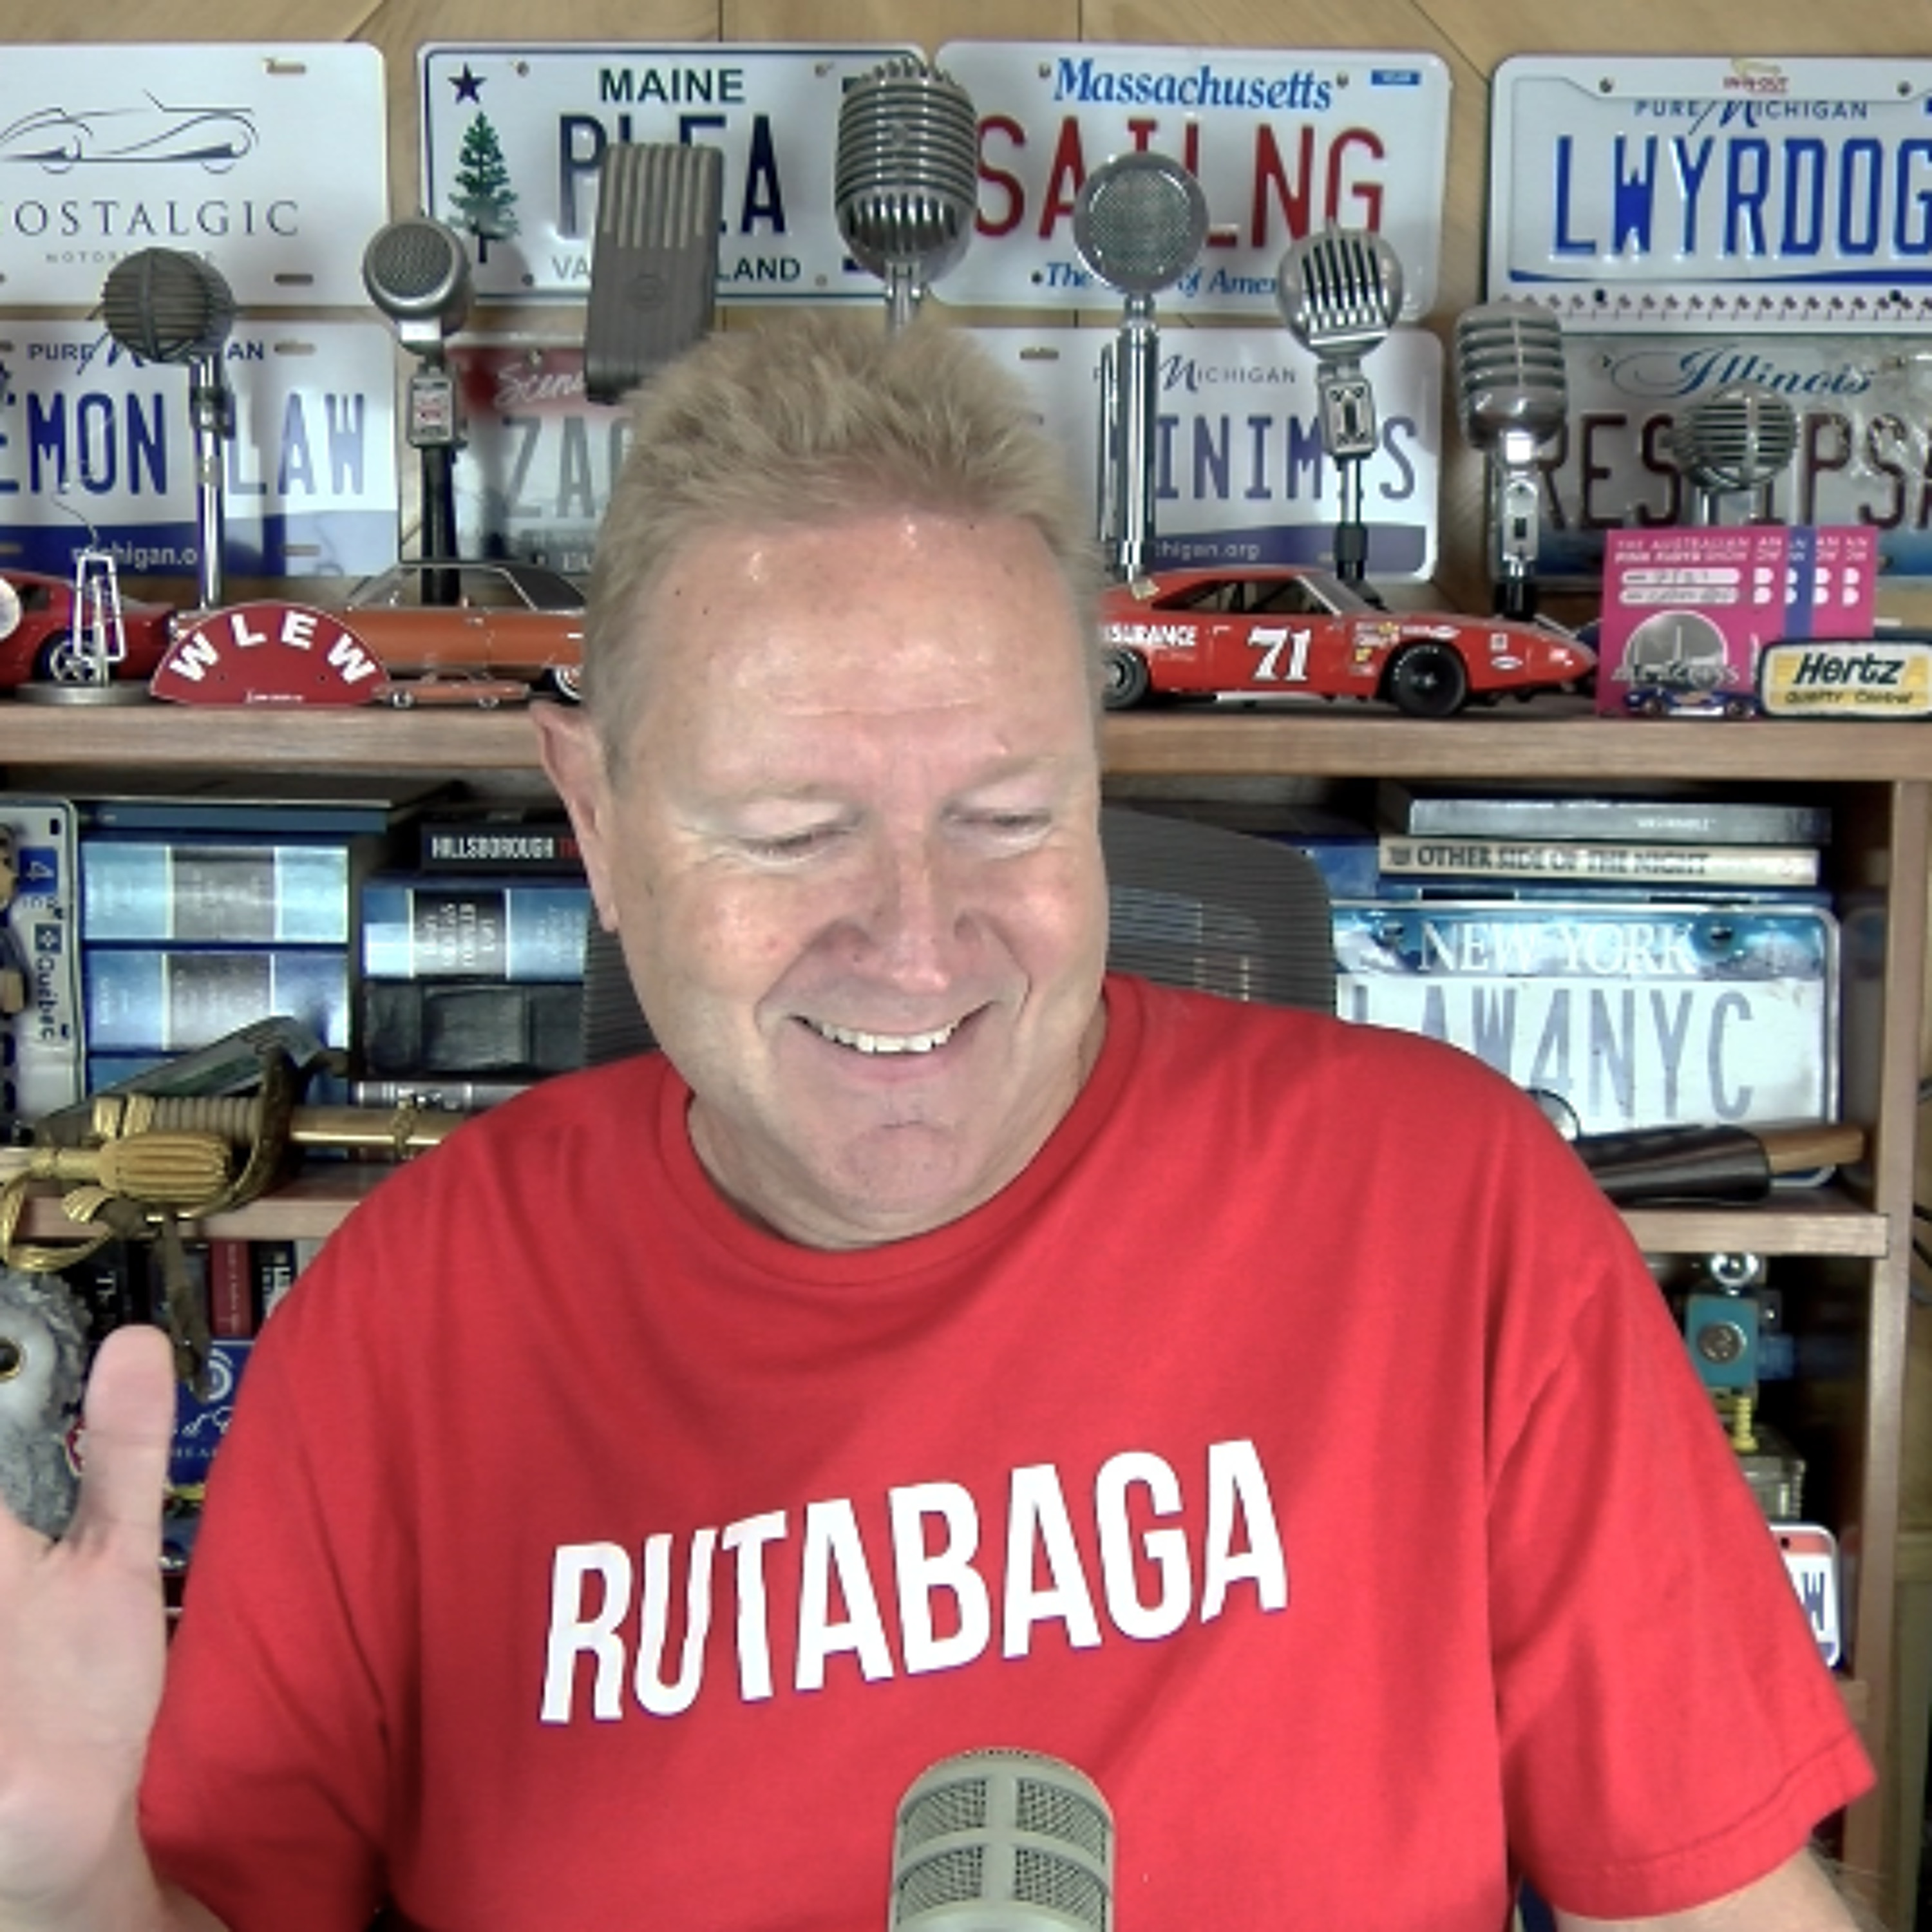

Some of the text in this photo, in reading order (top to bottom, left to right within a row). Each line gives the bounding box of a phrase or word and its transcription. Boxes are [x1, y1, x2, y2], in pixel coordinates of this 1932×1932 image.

[600, 68, 745, 103] MAINE
[1055, 58, 1332, 110] Massachusetts
[1634, 100, 1868, 128] PURE MICHIGAN
[0, 200, 300, 238] OSTALGIC
[1554, 134, 1932, 256] LWYRDOG
[1613, 343, 1877, 398] Illinois
[1110, 415, 1417, 500] INIMS
[1247, 626, 1311, 681] 71
[1793, 652, 1905, 685] Hertz
[432, 837, 554, 859] HILLSBOROUGH
[1417, 846, 1490, 867] OTHER
[1499, 848, 1545, 869] SIDE
[1417, 922, 1699, 975] NEW YORK
[540, 1438, 1288, 1725] RUTABAGA
